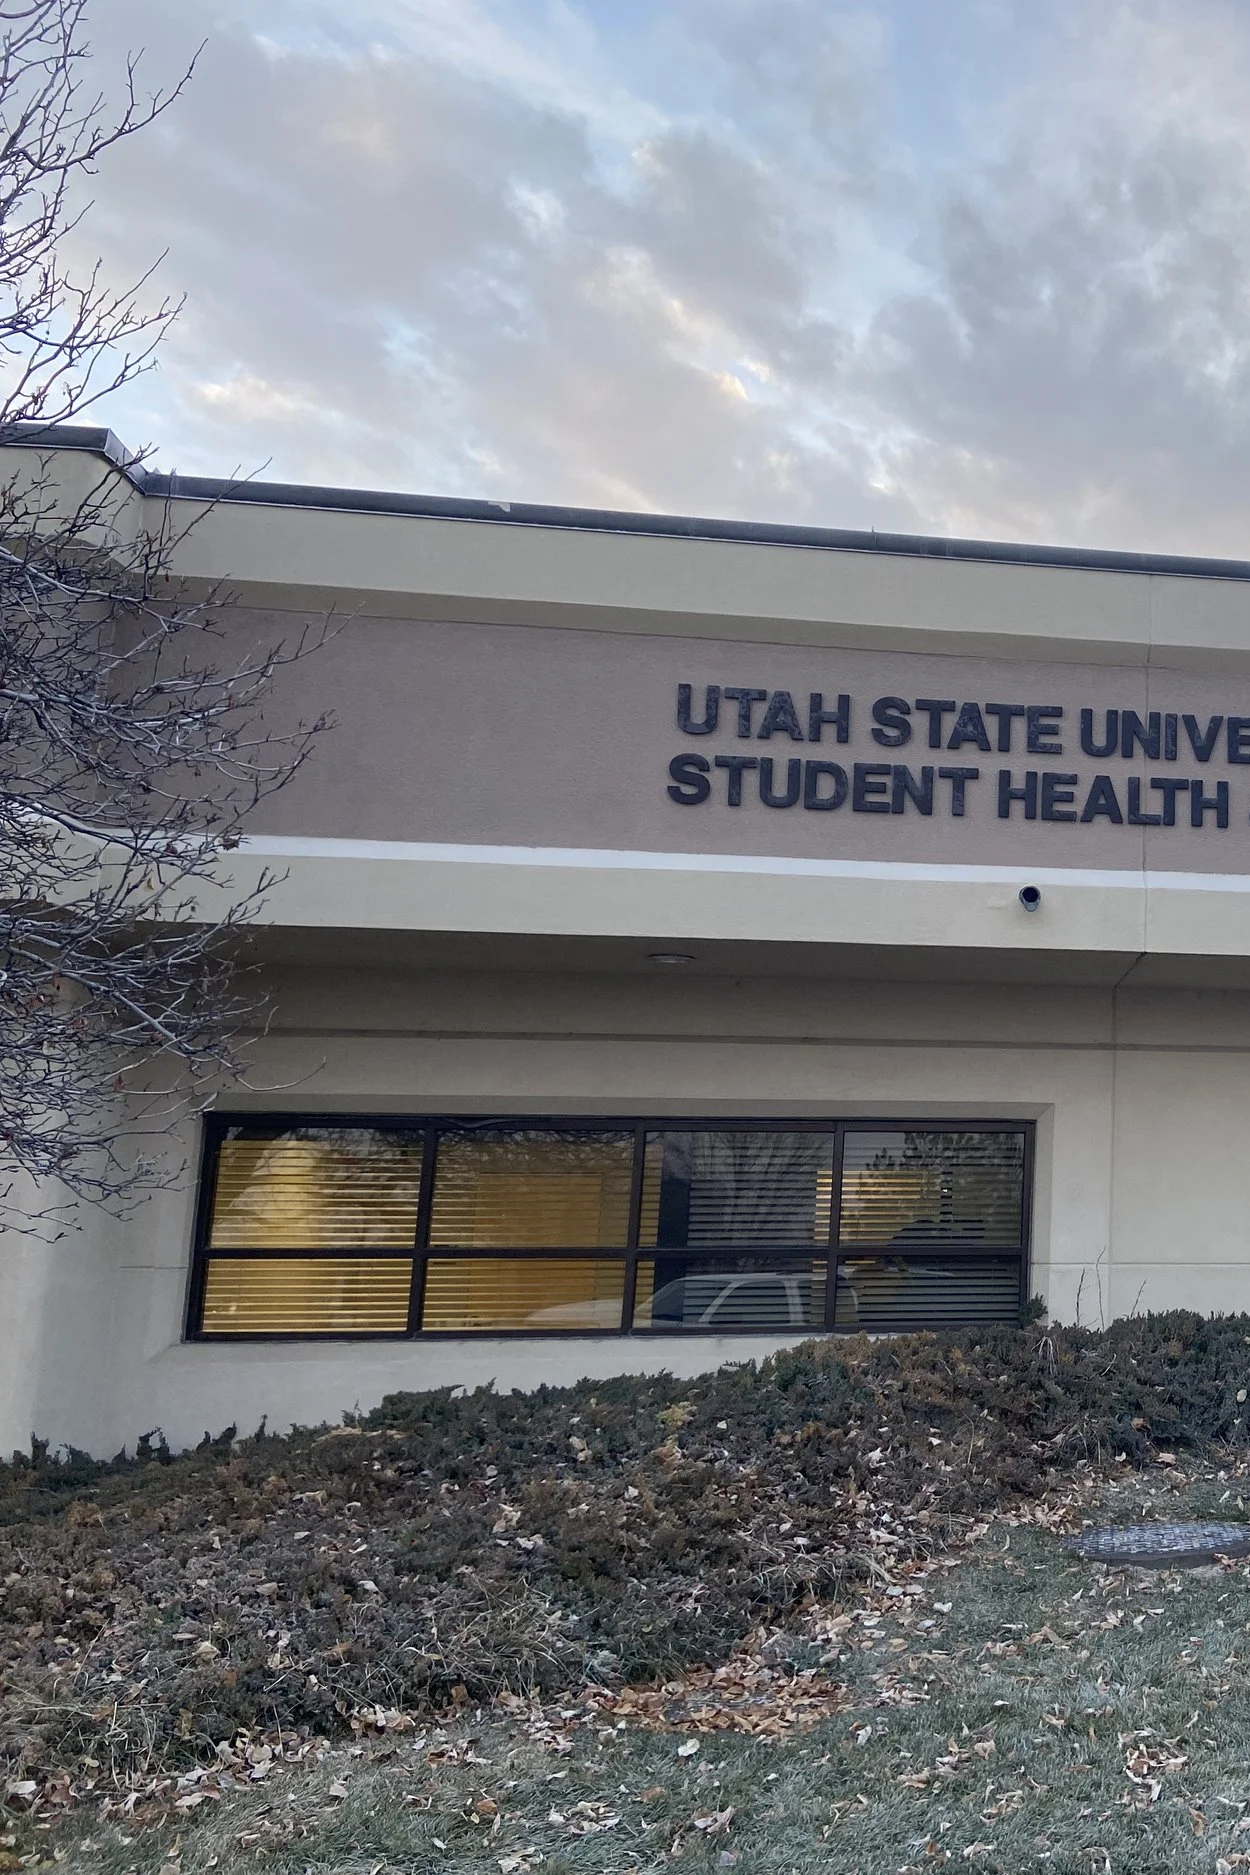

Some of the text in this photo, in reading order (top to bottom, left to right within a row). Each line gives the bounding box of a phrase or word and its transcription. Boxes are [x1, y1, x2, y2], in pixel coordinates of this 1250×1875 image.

[677, 683, 851, 745] UTAH
[870, 696, 1064, 756] STATE
[666, 752, 980, 817] STUDENT
[997, 769, 1229, 830] HEALTH
